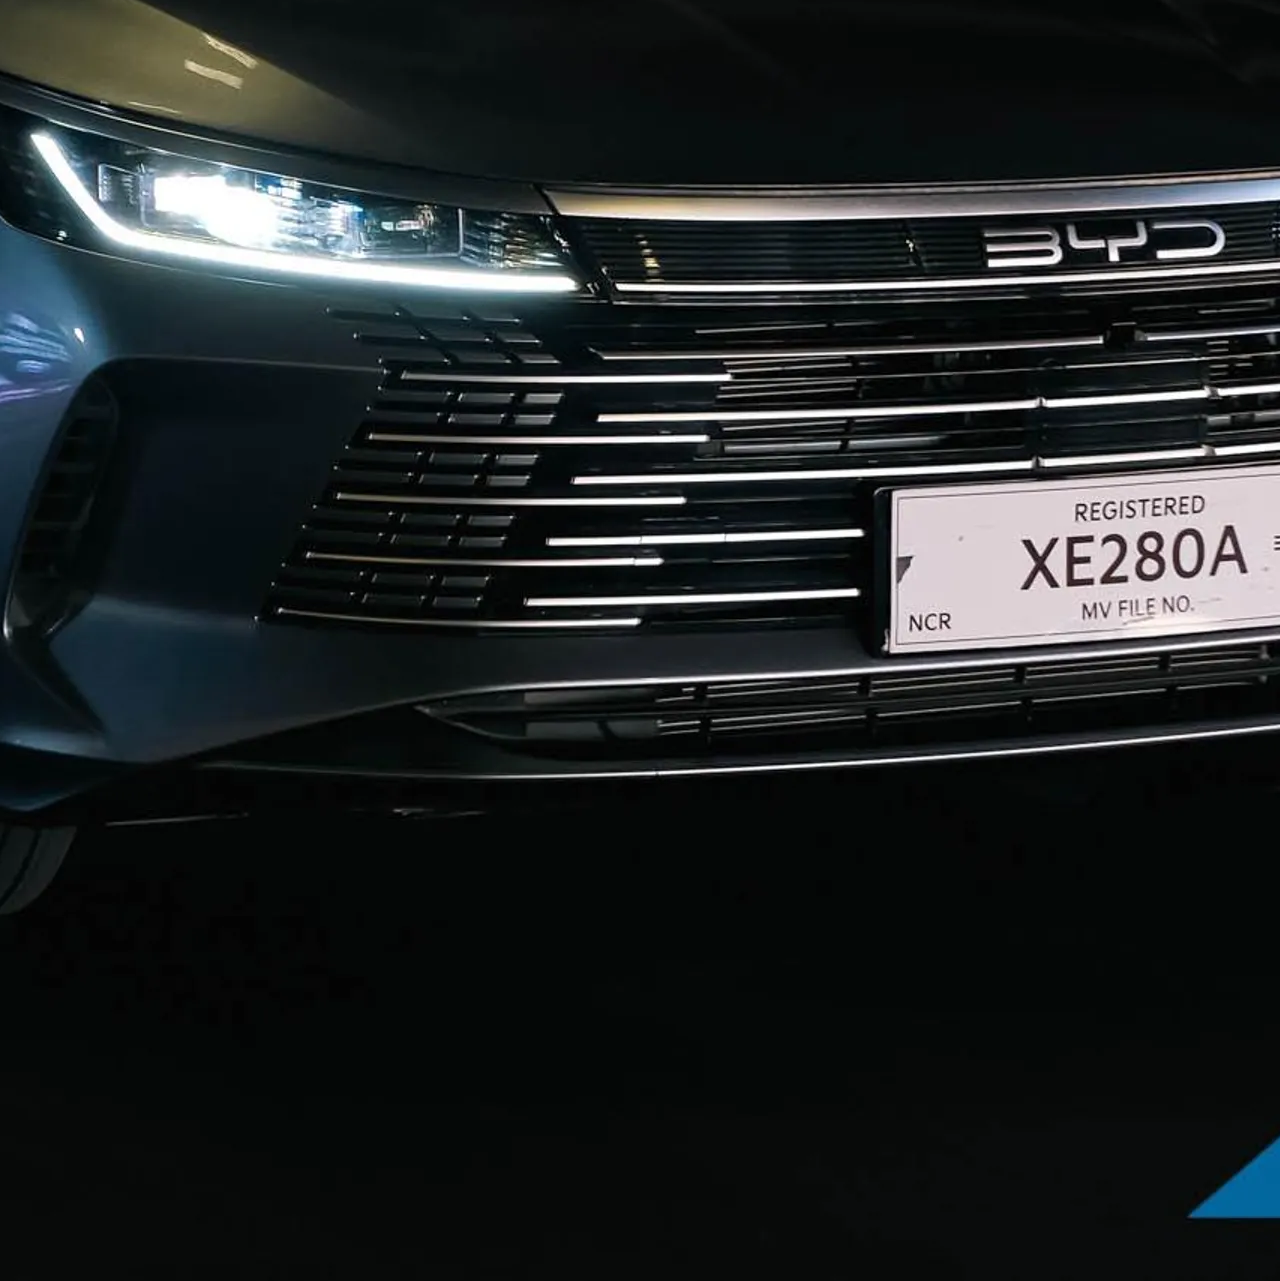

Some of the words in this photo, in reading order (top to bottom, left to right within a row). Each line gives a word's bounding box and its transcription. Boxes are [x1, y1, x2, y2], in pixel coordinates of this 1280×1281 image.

[983, 220, 1226, 268] BYD
[1075, 496, 1205, 522] REGISTERED
[1021, 525, 1248, 590] XE280A
[1082, 601, 1112, 621] MV
[1118, 597, 1157, 618] FILE
[1162, 595, 1196, 615] NO.
[909, 612, 951, 631] NCR
